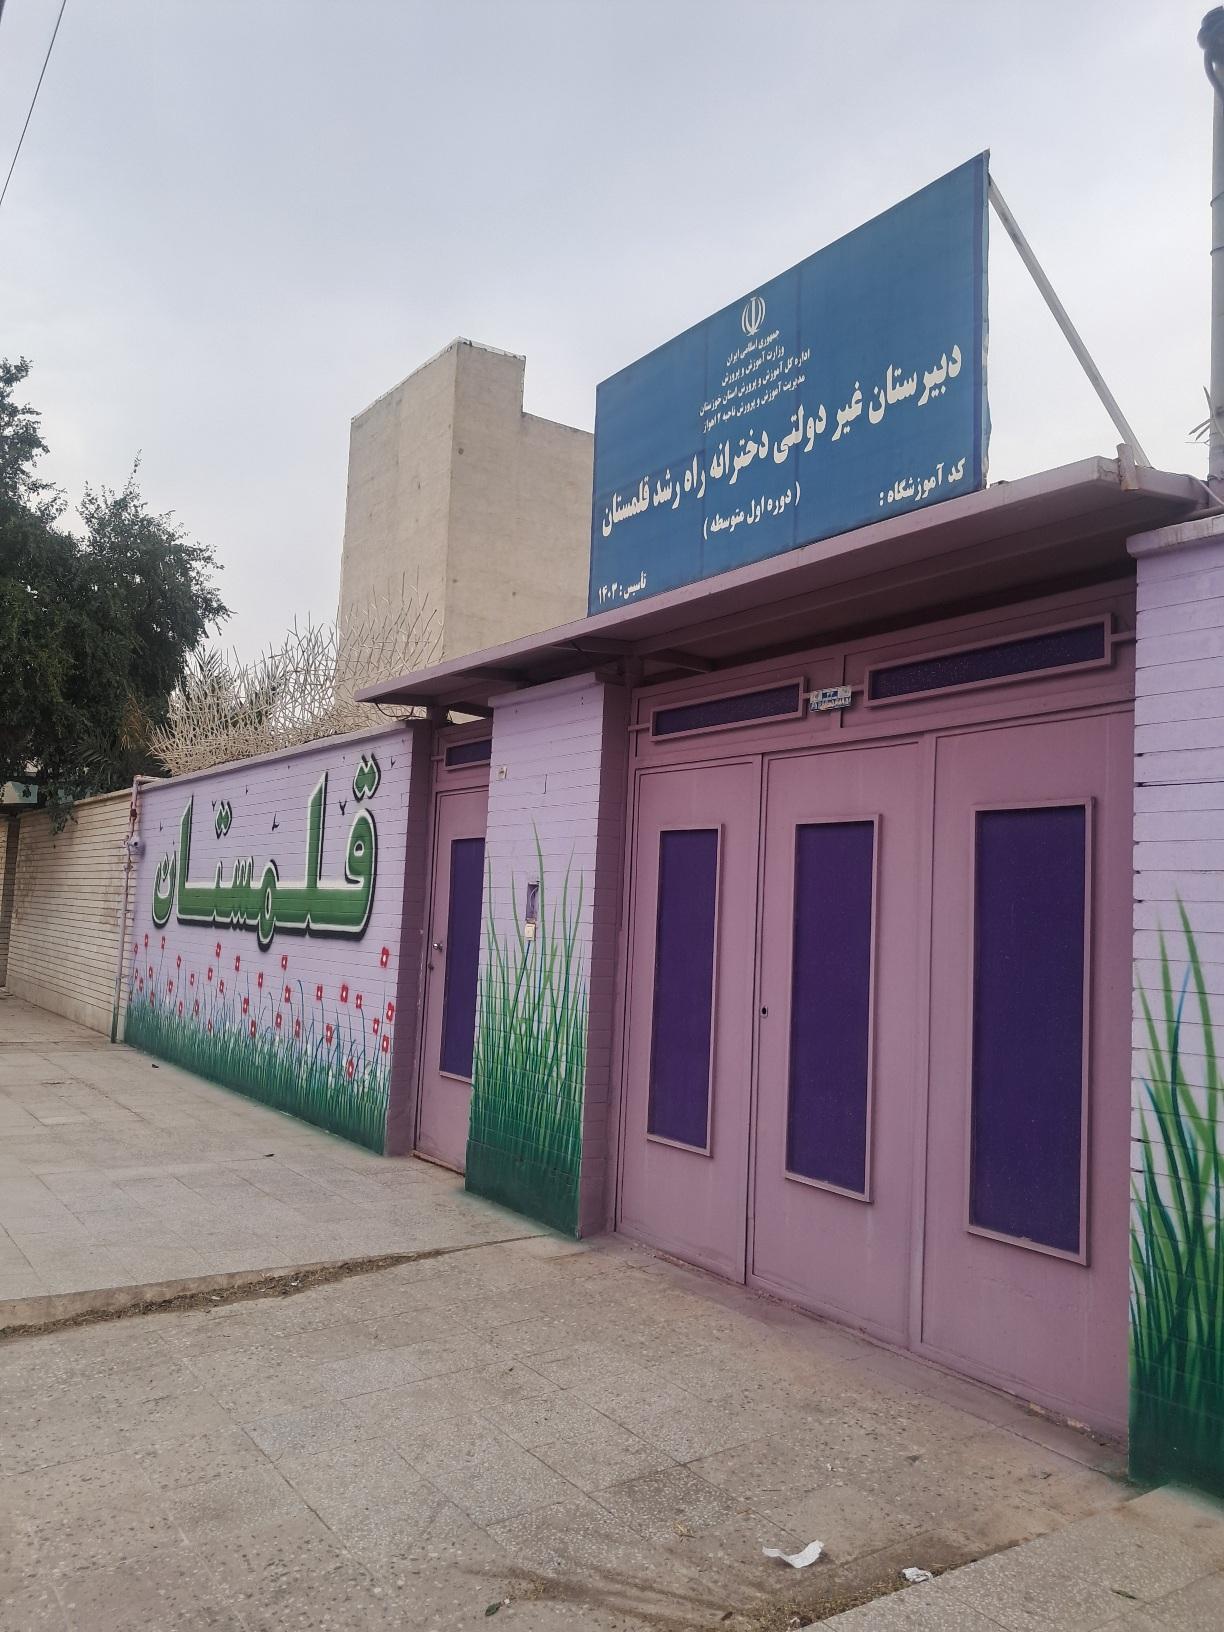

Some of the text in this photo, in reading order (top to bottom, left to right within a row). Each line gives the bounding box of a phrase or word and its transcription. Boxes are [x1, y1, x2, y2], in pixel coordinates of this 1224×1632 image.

[726, 329, 780, 366] جمهوری اسلامی ایران
[721, 345, 785, 387] وزارت آموزش و پرورش
[699, 348, 810, 417] اداره کل آموزش و پرورش استان خوزستان
[761, 381, 783, 405] آموزش
[783, 374, 806, 391] مدیریت
[722, 406, 736, 421] ناحیه
[736, 398, 756, 416] پرورش
[756, 398, 760, 408] و
[702, 413, 718, 434] اهواز
[602, 344, 962, 537] دبیرستان غیر دولتی دخترانه راه رشد قلمستان
[947, 457, 966, 483] کد
[746, 495, 765, 525] اول
[598, 582, 618, 604] ۱۴۰۳
[152, 753, 381, 950] قلمستان
